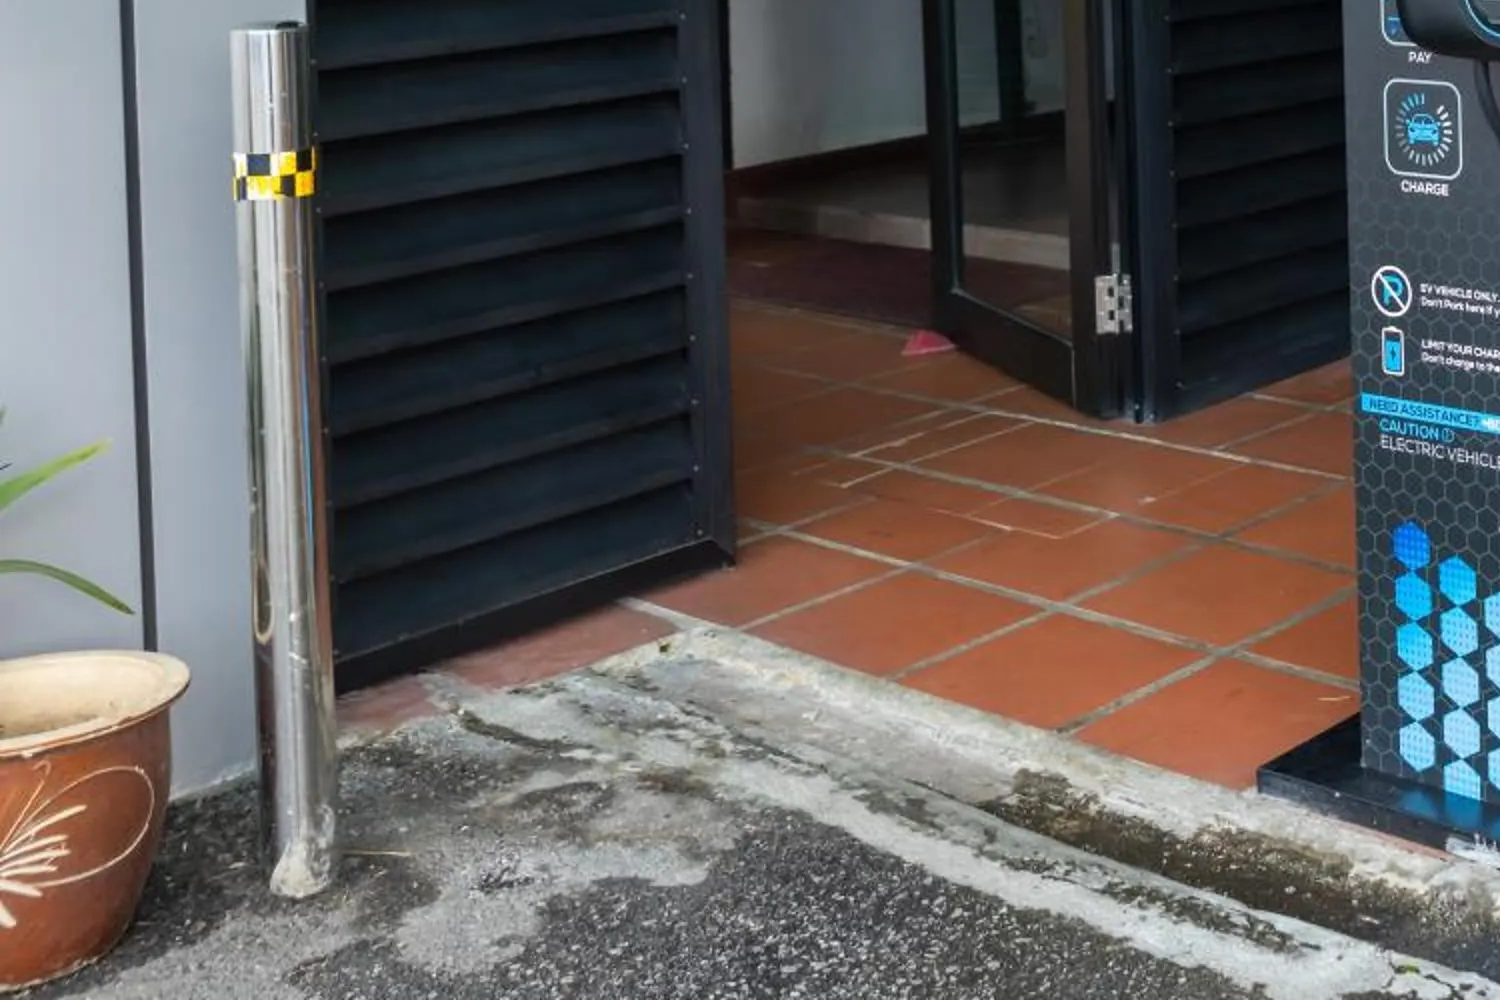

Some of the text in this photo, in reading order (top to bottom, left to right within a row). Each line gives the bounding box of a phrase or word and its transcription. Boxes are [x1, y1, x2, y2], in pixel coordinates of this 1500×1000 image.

[1408, 51, 1432, 64] PAY
[1400, 179, 1449, 197] CHARGE
[1420, 283, 1433, 295] EV
[1433, 284, 1473, 299] VEHICLE
[1421, 338, 1445, 351] LIMIT
[1445, 342, 1473, 355] YOUR
[1369, 399, 1399, 413] NEED
[1400, 401, 1479, 428] ASSISTANCE?
[1379, 417, 1439, 441] CAUTION
[1380, 433, 1445, 459] ELECTRIC
